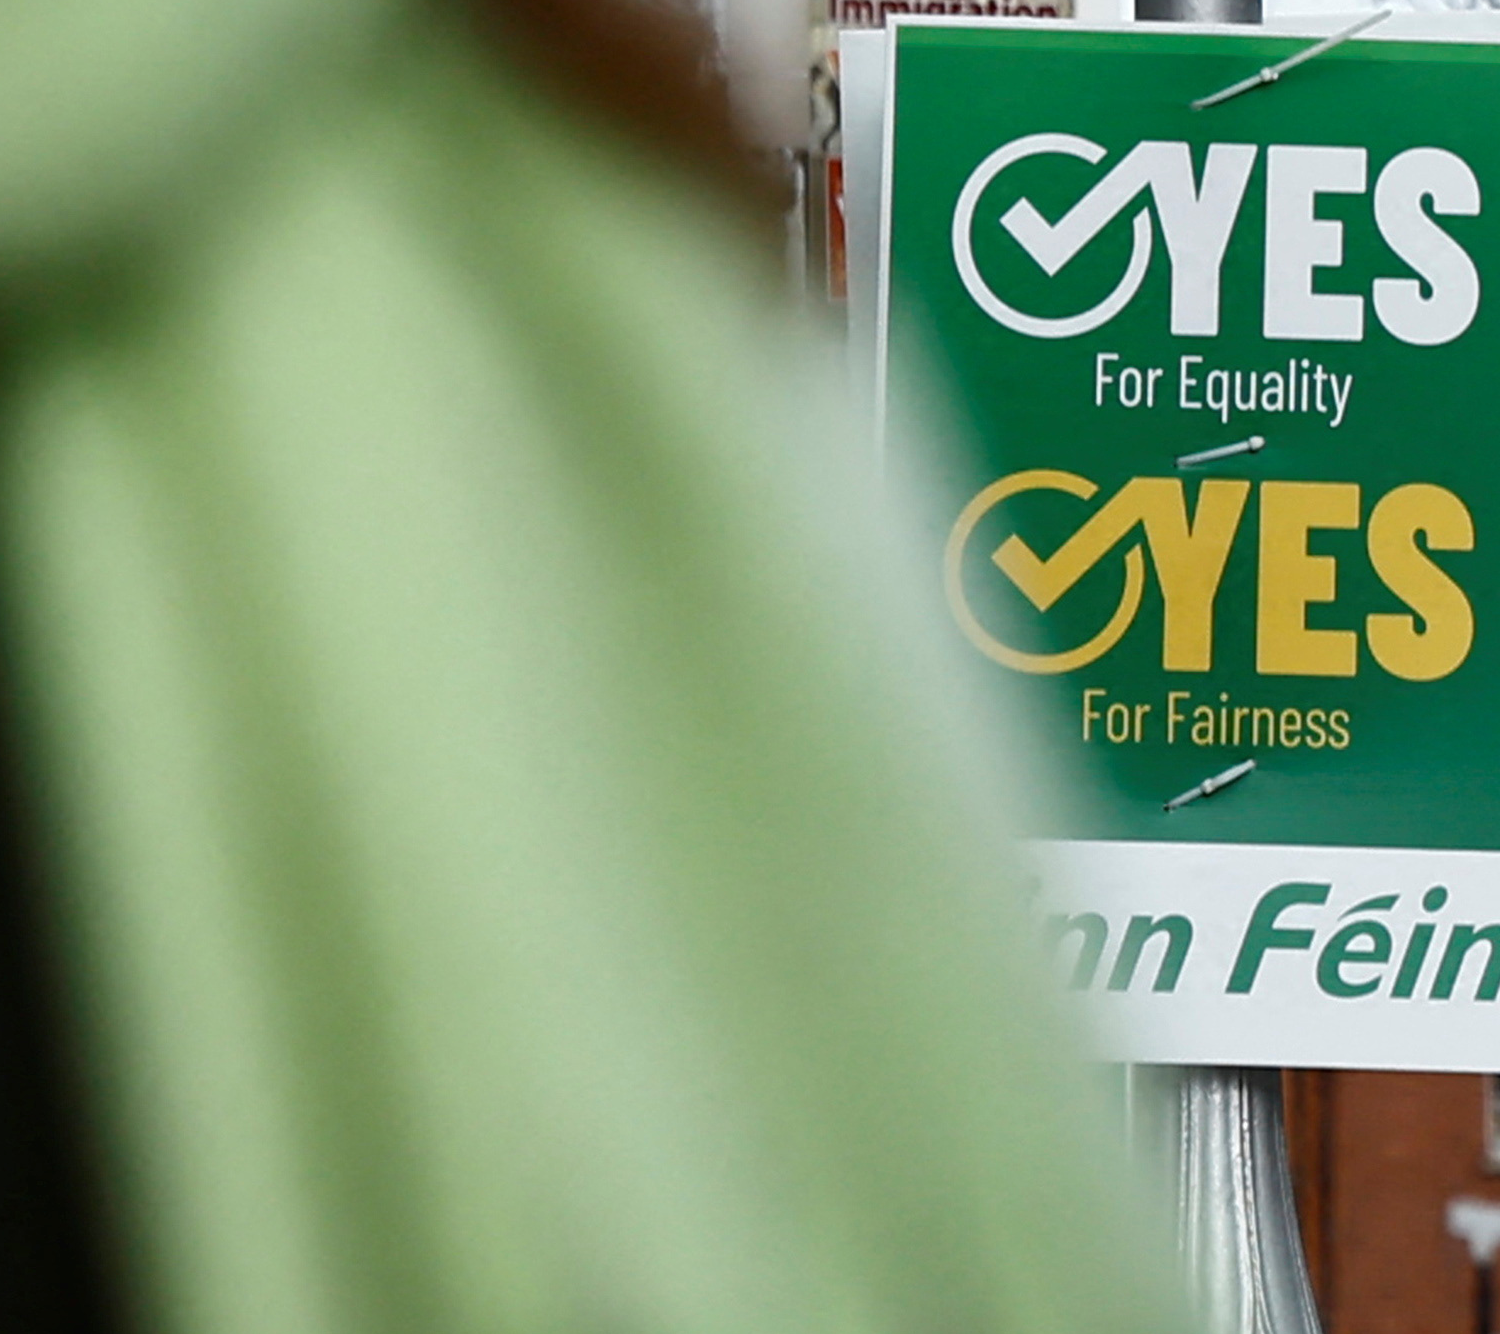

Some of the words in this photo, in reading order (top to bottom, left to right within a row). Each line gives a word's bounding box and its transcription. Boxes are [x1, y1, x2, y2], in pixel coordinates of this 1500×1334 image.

[1130, 140, 1481, 346] YES
[1095, 353, 1163, 407] For
[1179, 355, 1353, 427] Equality
[1124, 477, 1474, 682] YES
[1082, 689, 1150, 743] For
[1167, 691, 1351, 750] Fairness
[1032, 905, 1194, 994] nn
